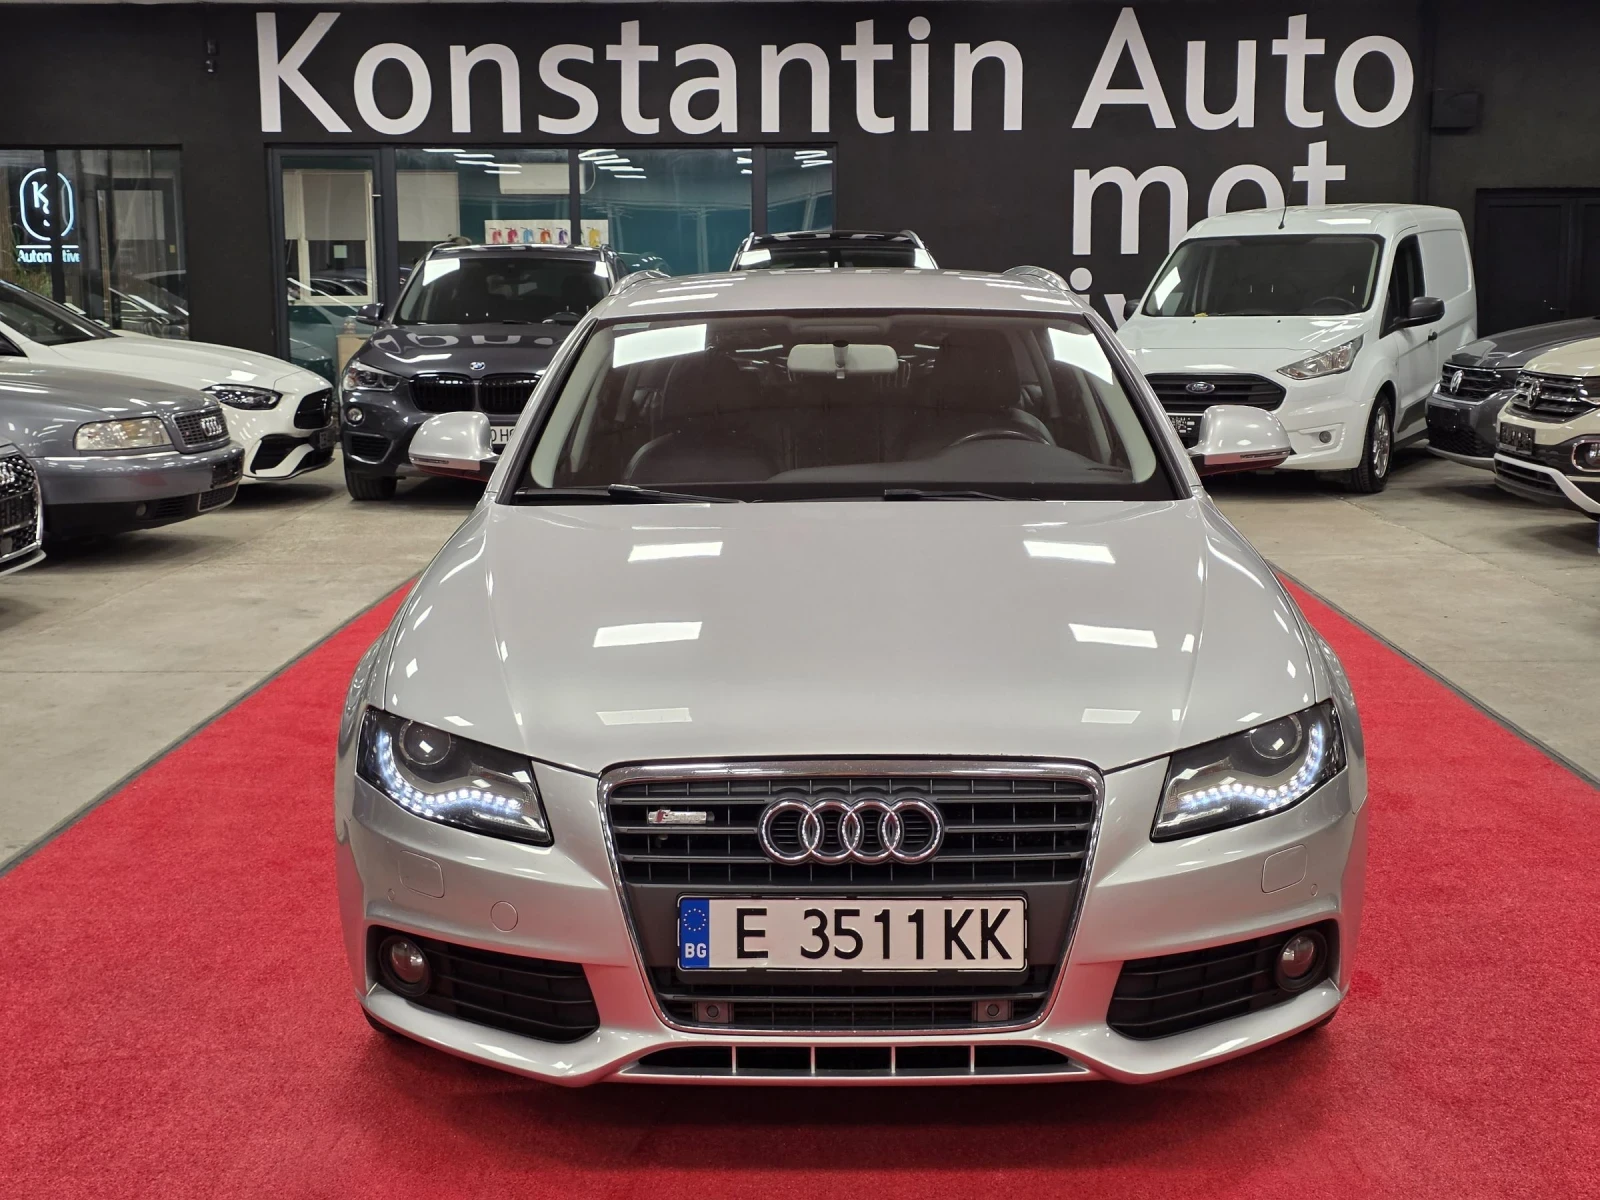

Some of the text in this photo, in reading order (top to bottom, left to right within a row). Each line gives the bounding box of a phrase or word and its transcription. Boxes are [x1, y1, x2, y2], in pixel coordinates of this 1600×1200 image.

[257, 8, 1414, 135] Konstantin Auto
[500, 428, 515, 442] H
[684, 942, 707, 958] BG
[737, 908, 769, 959] E
